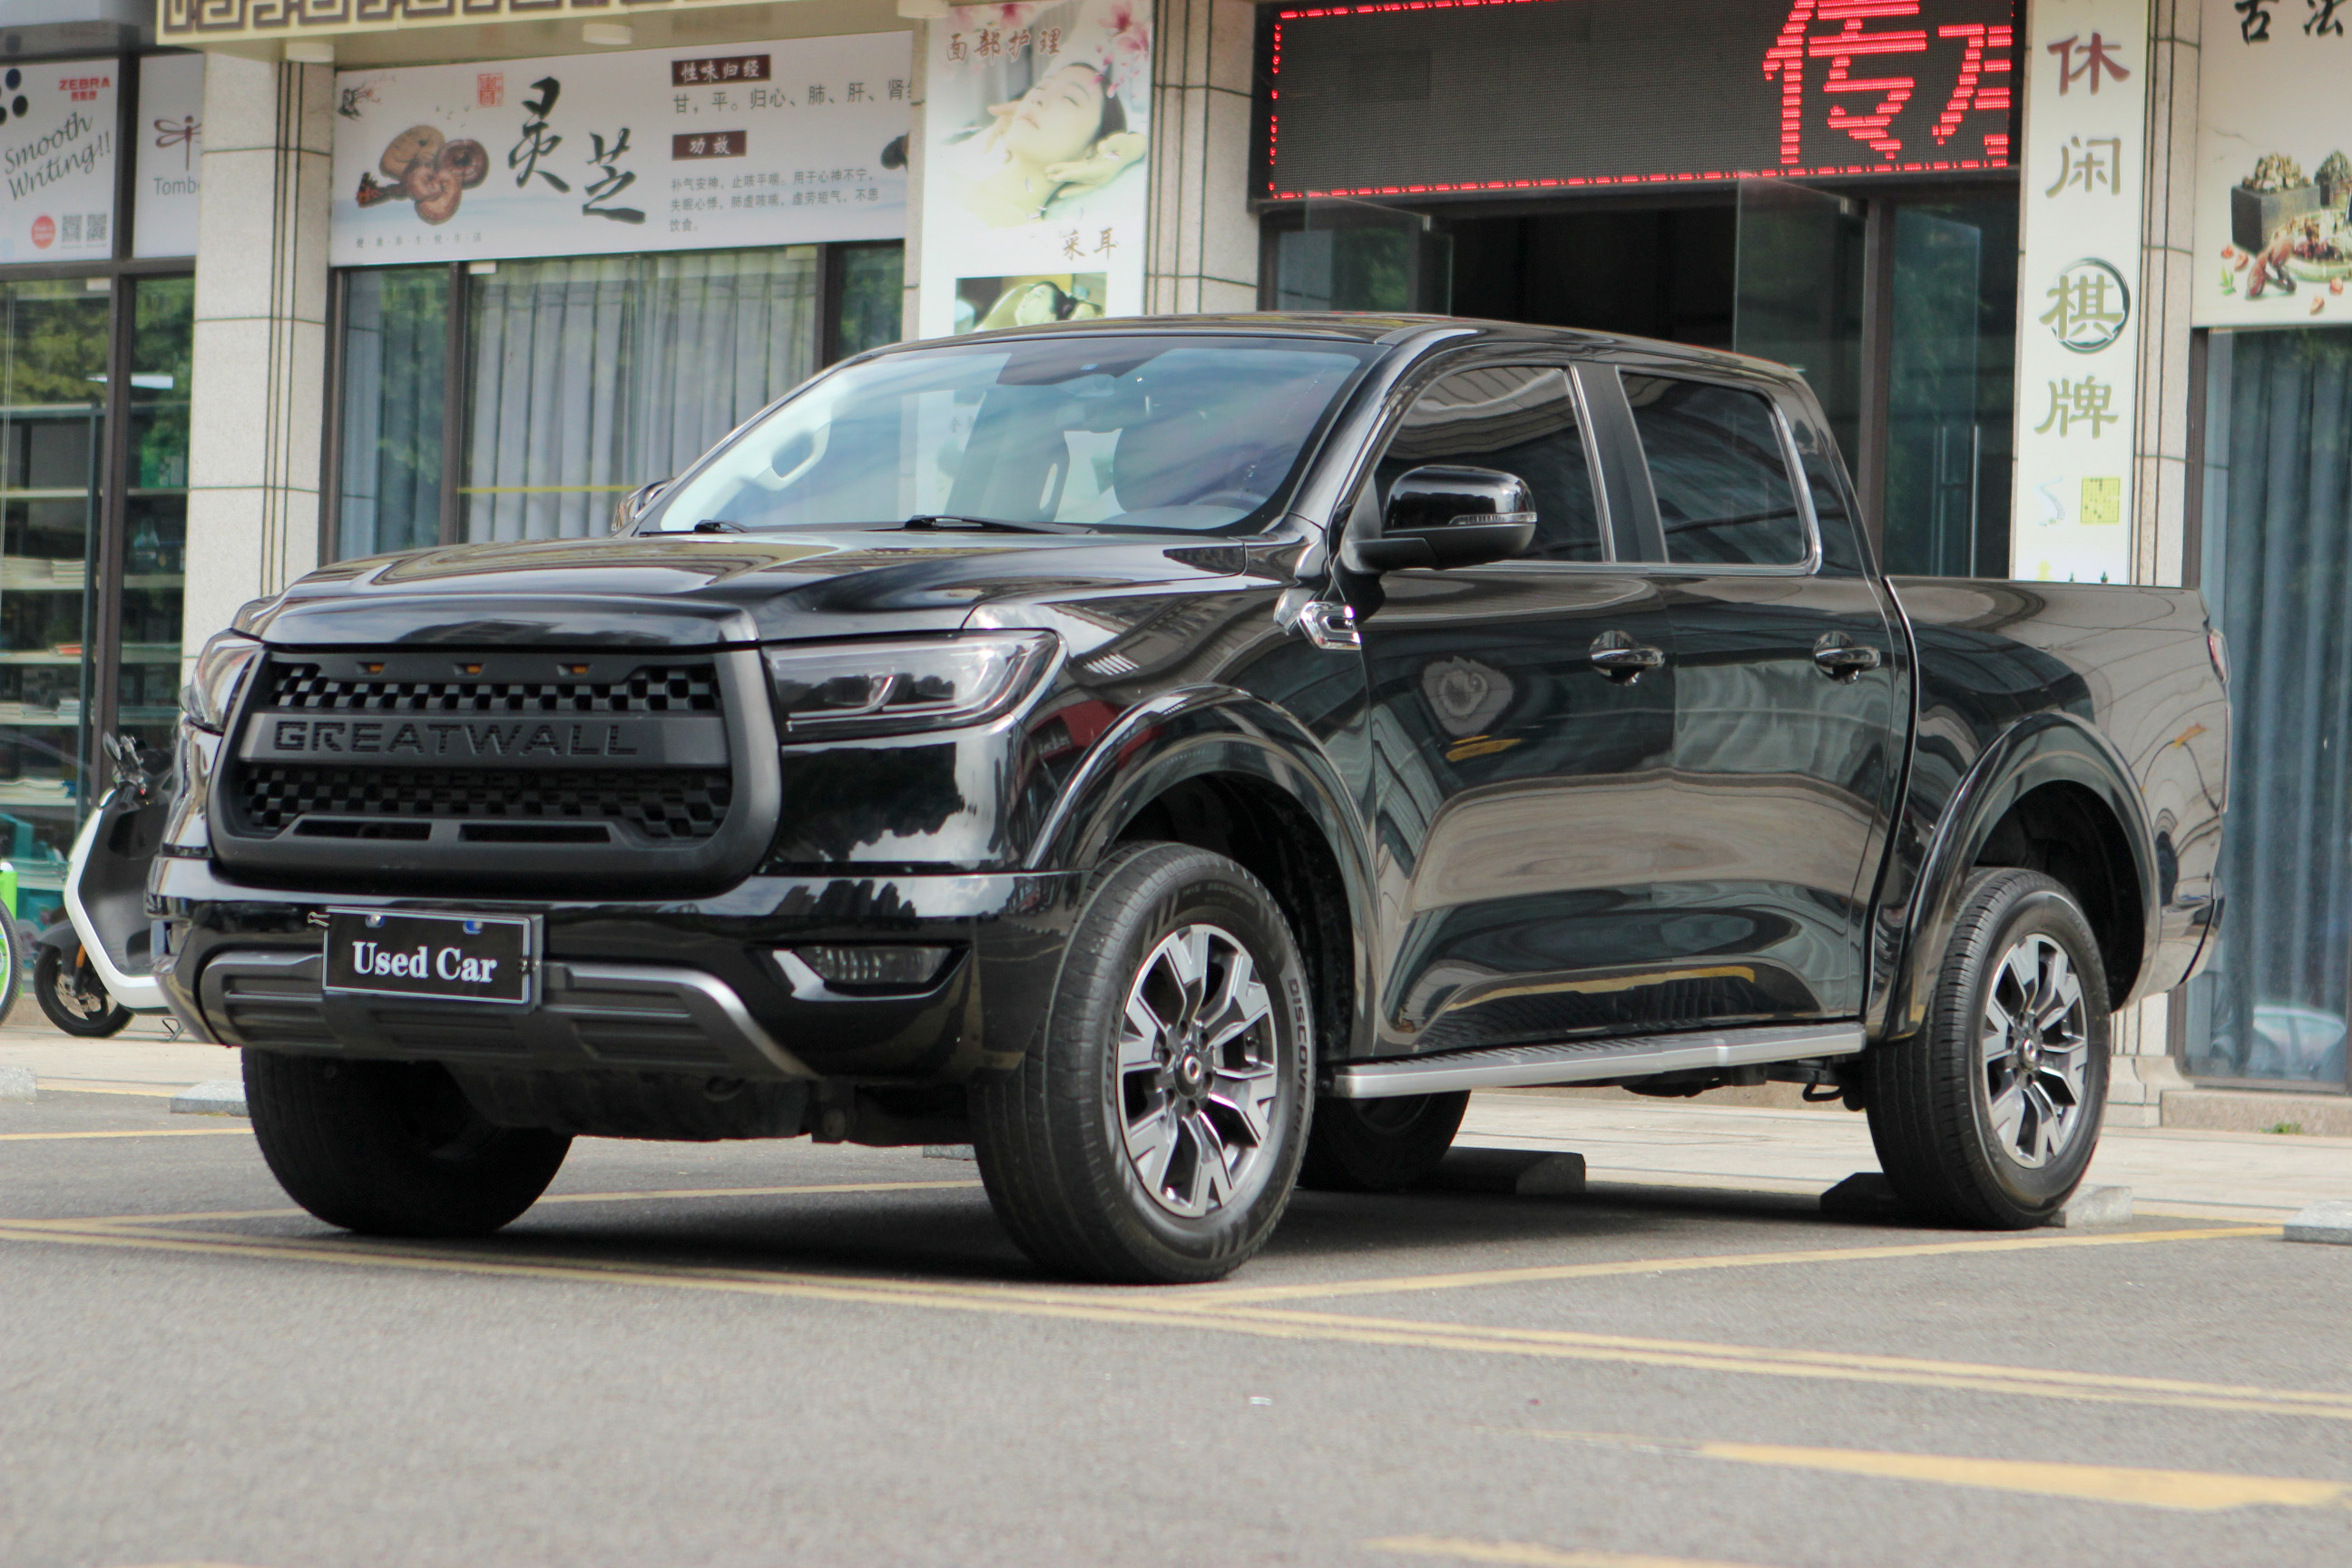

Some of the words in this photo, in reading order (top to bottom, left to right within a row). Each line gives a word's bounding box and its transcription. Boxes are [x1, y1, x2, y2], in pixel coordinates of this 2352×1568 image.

[946, 28, 1063, 64] 面部护理
[59, 76, 111, 91] ZEBRA
[681, 60, 760, 83] 性味归经
[5, 112, 93, 174] Smooth
[508, 75, 647, 225] 灵芝
[689, 134, 730, 155] 功效
[8, 131, 111, 201] Writing!!
[1063, 227, 1119, 261] 采耳
[2033, 31, 2132, 441] 休闲棋牌
[274, 720, 639, 756] GREATWALL
[352, 940, 429, 979] Used
[436, 946, 498, 983] Car
